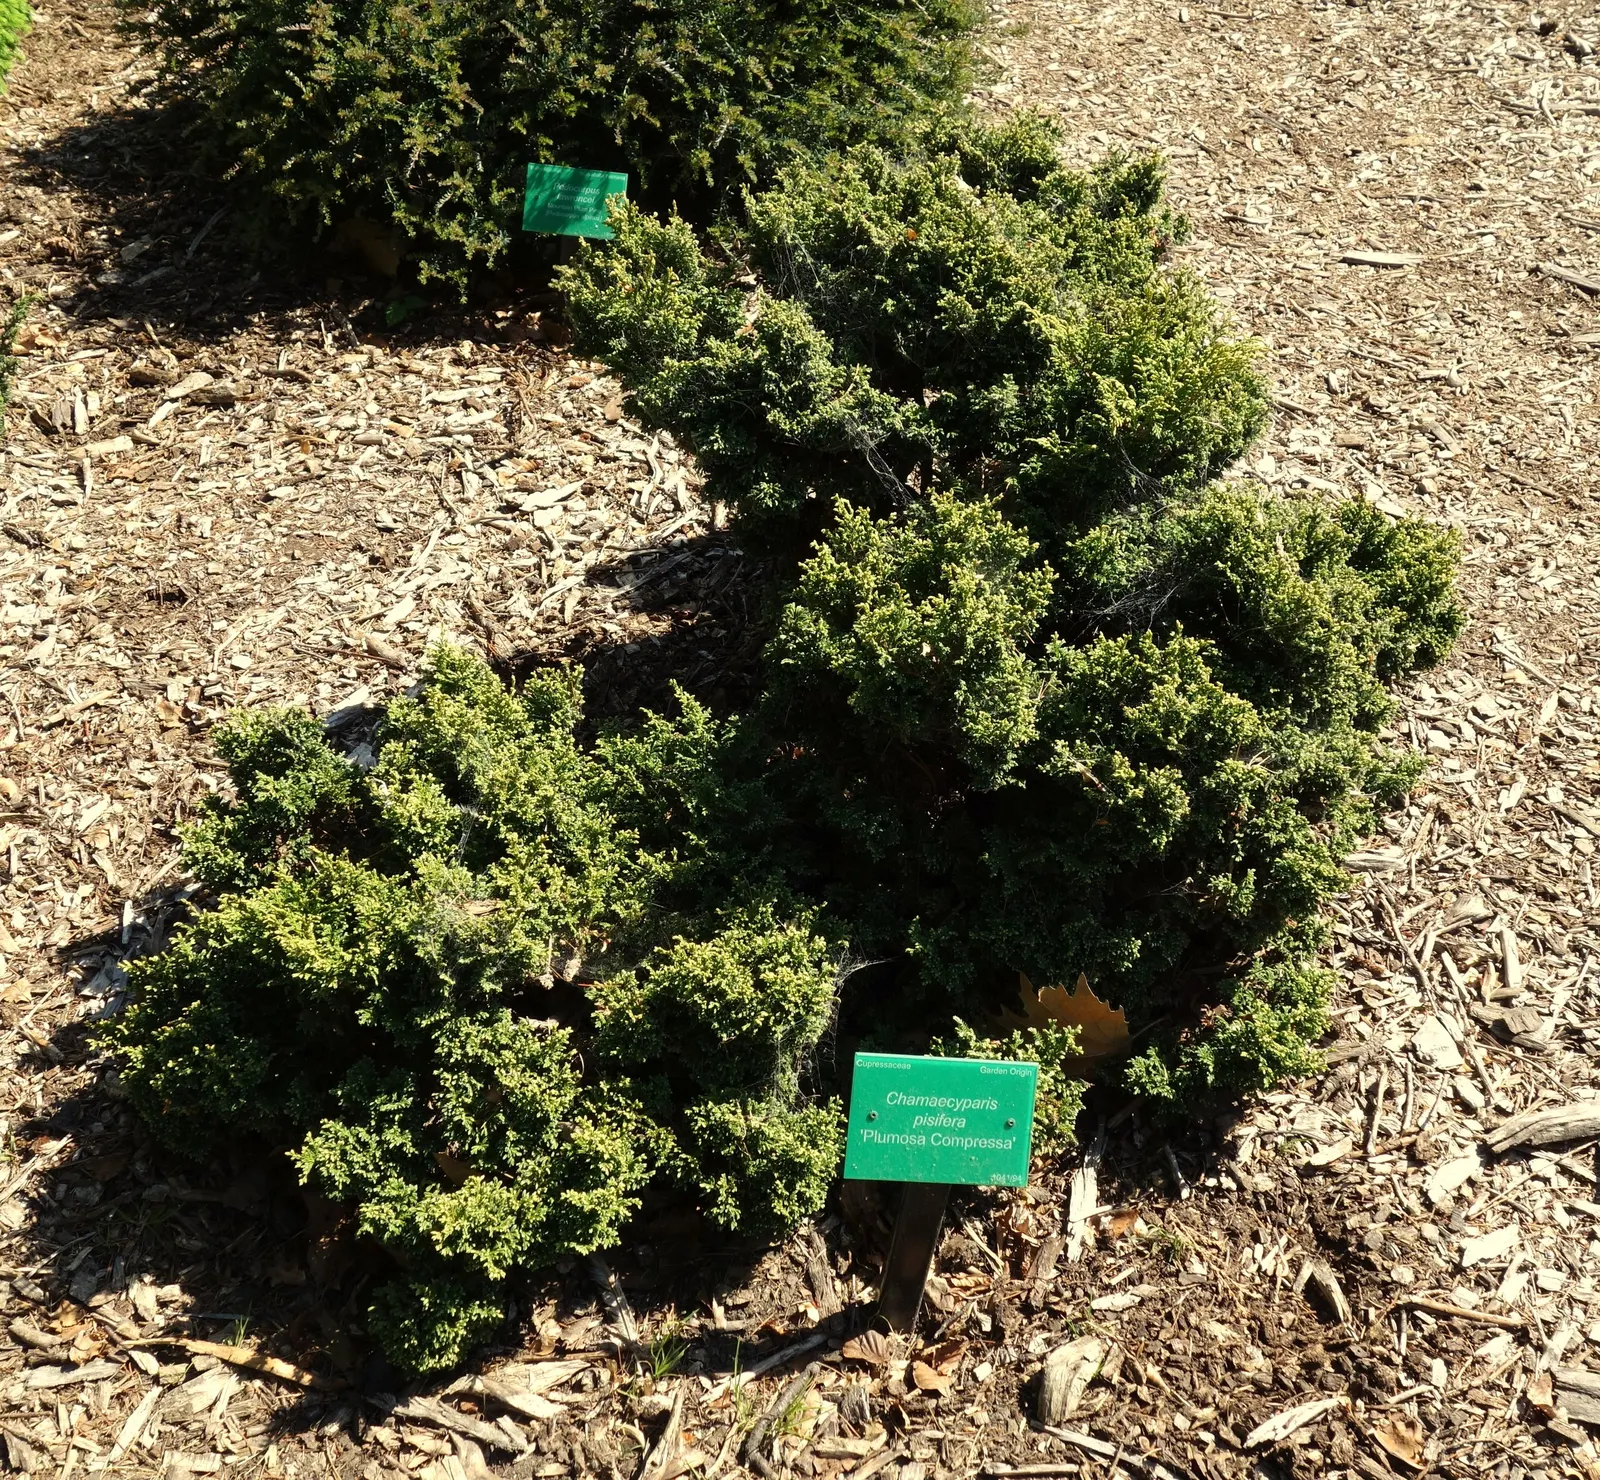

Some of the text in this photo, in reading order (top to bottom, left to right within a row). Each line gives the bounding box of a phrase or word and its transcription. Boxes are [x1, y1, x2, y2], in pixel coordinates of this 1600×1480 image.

[553, 182, 600, 195] Podocarpus
[856, 1059, 912, 1070] Cupressaceae
[980, 1066, 1032, 1077] Garden Origin
[886, 1091, 999, 1111] Chamaecyparis
[913, 1113, 966, 1129] pisifera
[860, 1129, 1017, 1151] 'Plumosa Compressa'
